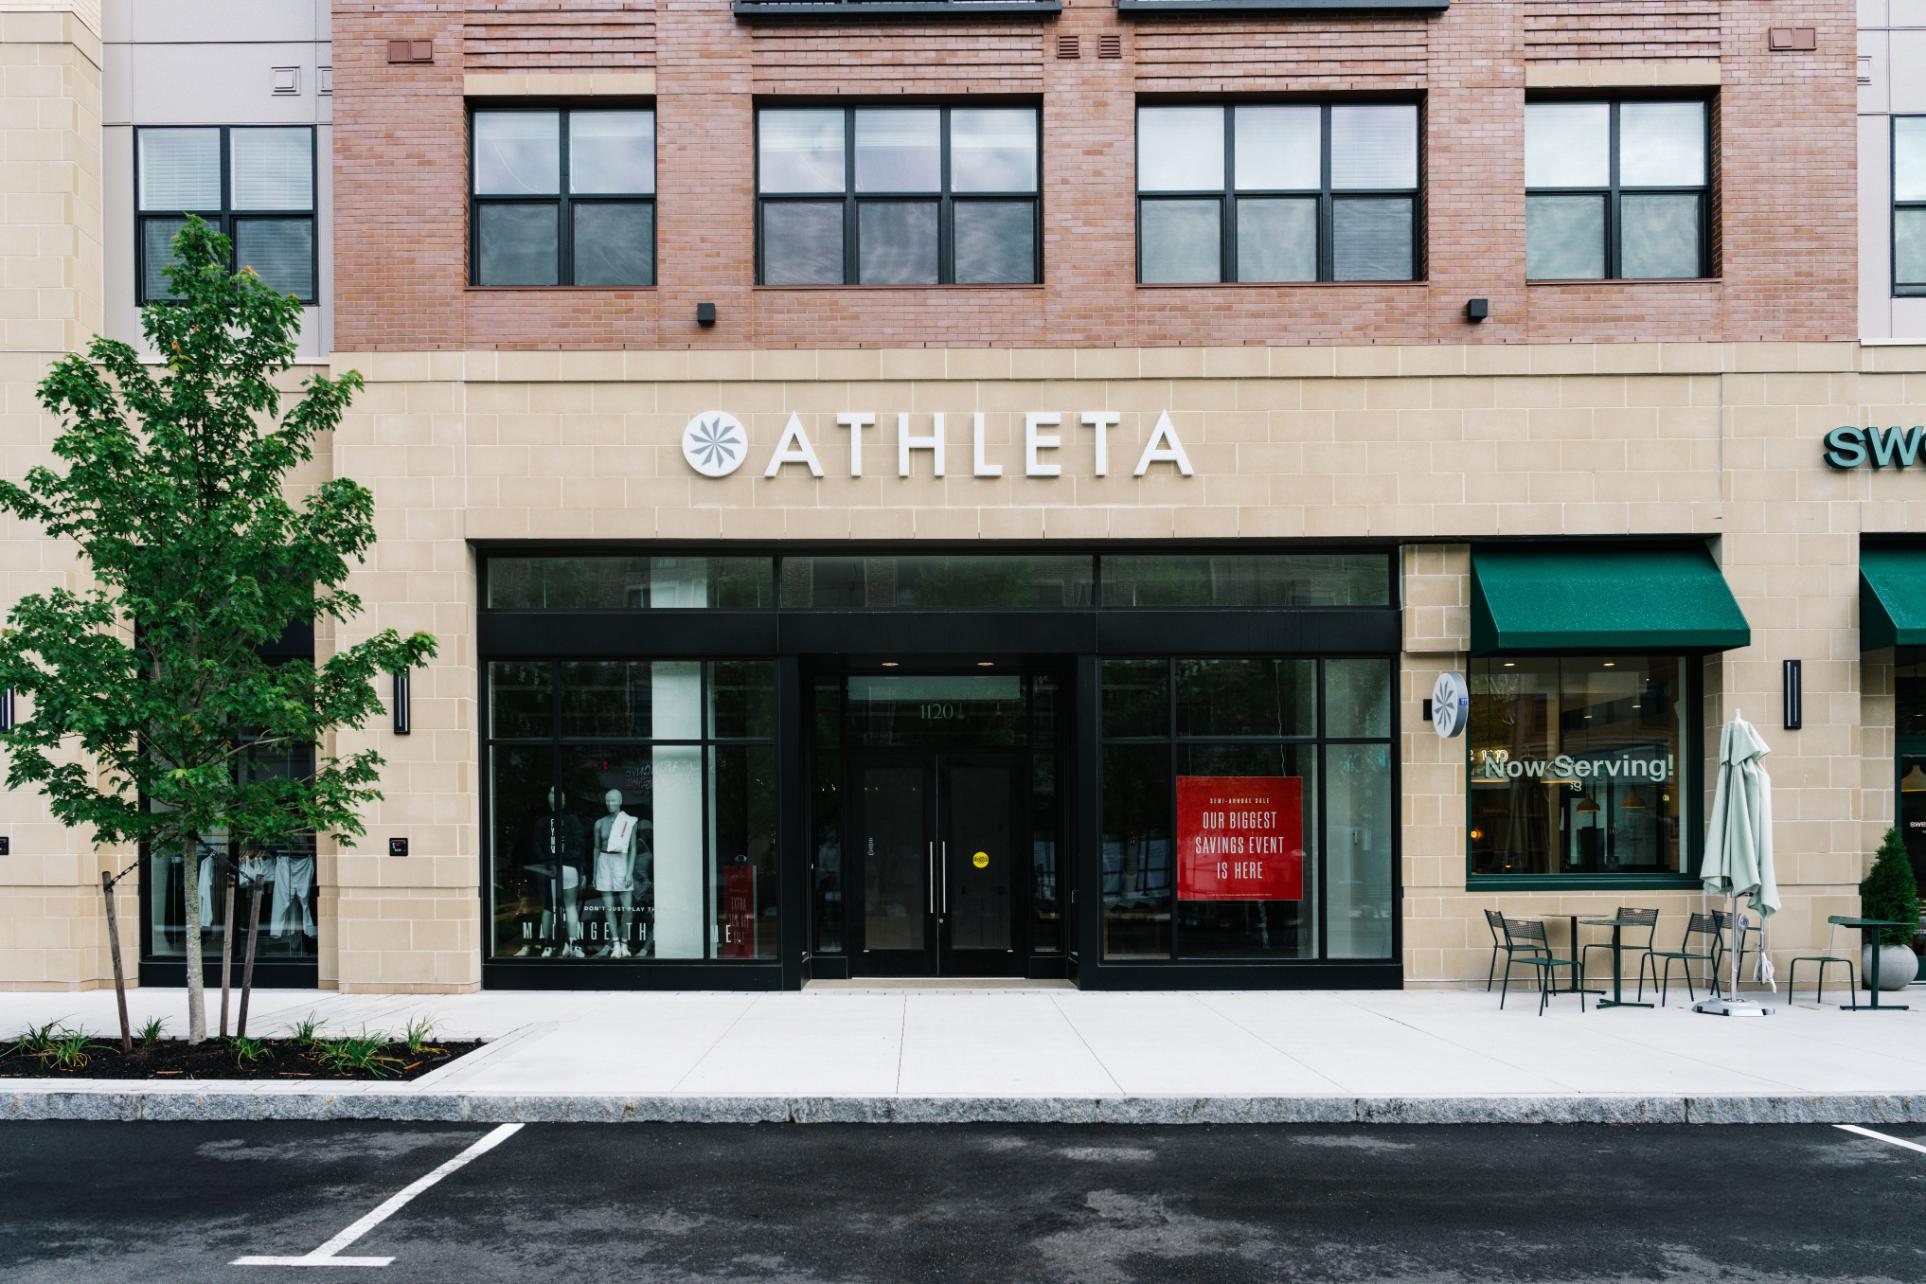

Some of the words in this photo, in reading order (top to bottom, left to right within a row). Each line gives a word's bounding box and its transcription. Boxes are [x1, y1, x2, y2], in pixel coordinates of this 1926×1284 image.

[764, 408, 1194, 477] ATHLETA
[920, 703, 954, 720] 1120
[1485, 755, 1546, 778] Now
[1554, 753, 1674, 782] Serving!
[1202, 811, 1225, 829] OUR
[1230, 811, 1277, 829] BIGGEST
[1195, 836, 1244, 854] SAVINGS
[1249, 836, 1284, 854] EVENT
[1217, 861, 1228, 879] IS
[1235, 861, 1263, 879] HERE
